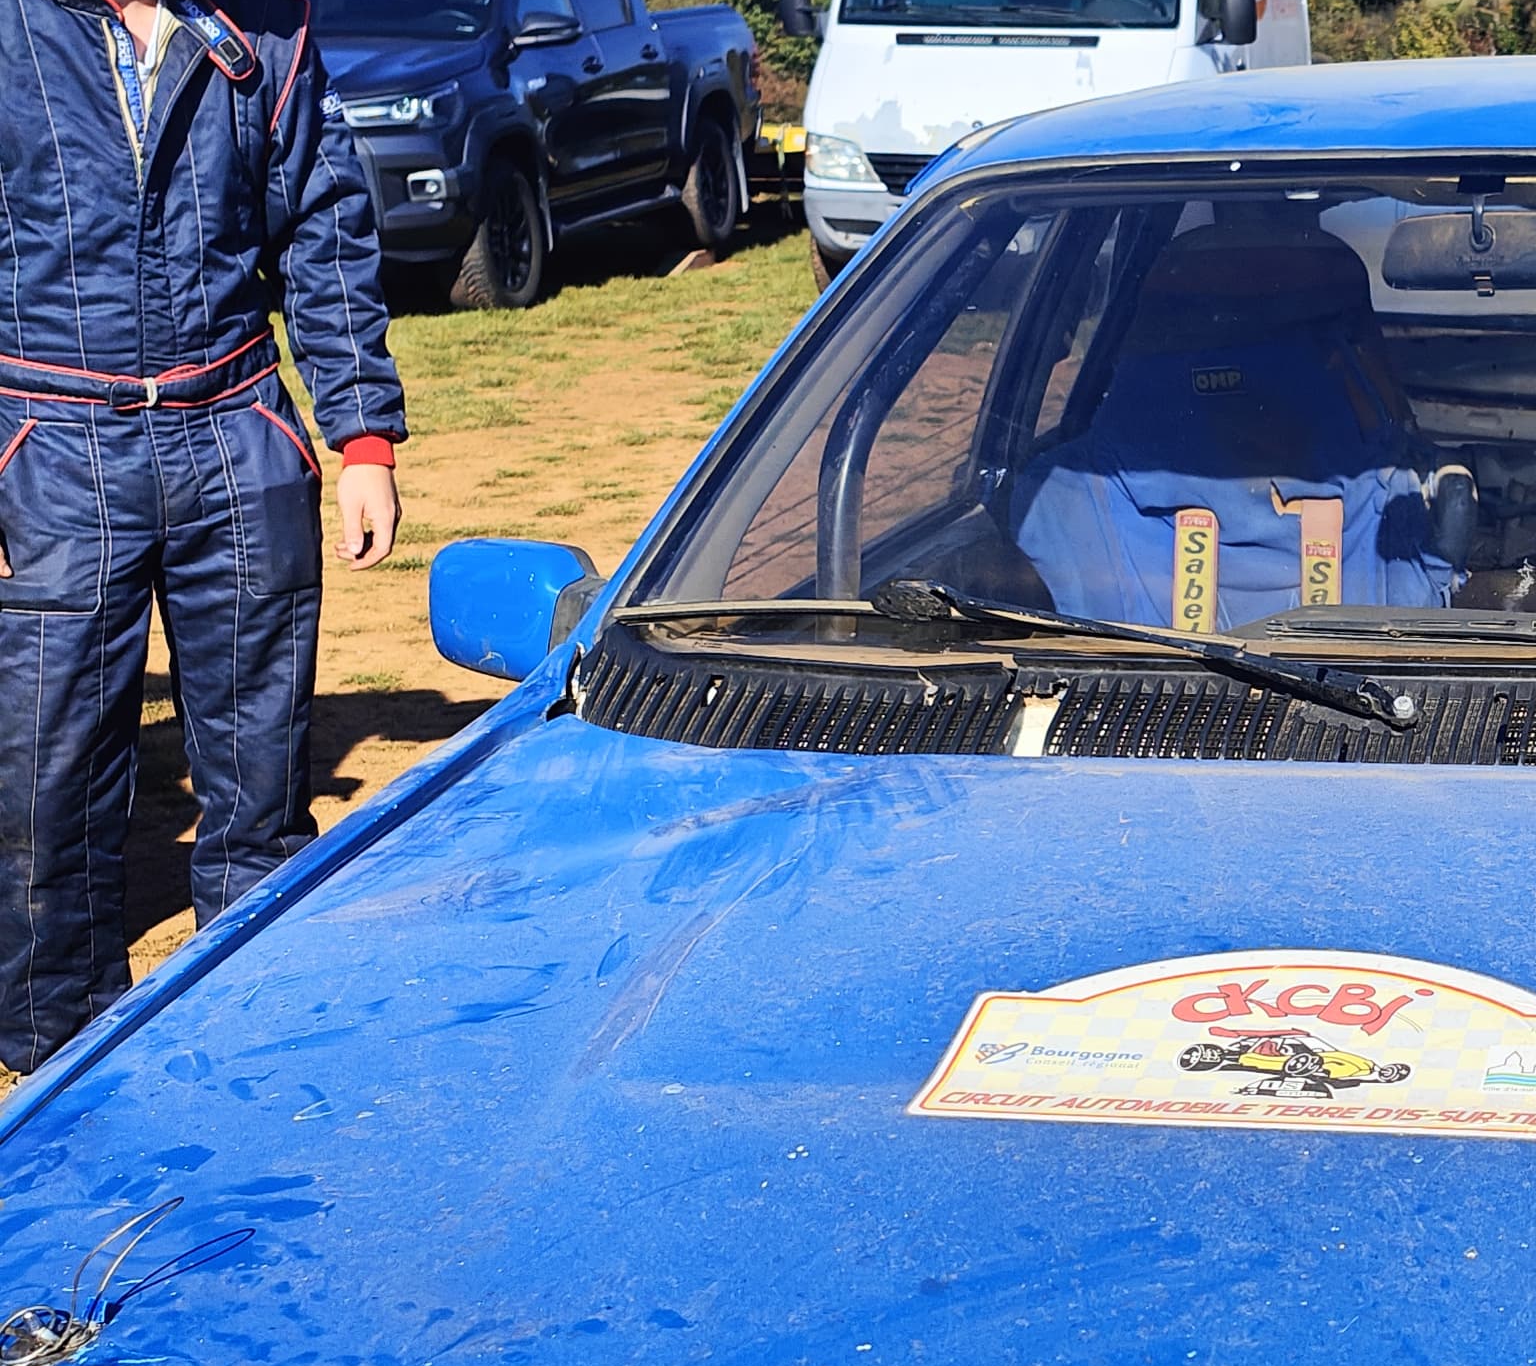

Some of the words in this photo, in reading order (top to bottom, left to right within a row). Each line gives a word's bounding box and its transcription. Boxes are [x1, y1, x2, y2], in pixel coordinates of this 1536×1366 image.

[1030, 1046, 1143, 1061] Bourgogne
[938, 1091, 1056, 1107] CIRCUIT
[1052, 1096, 1254, 1116] AUTOMOBILE
[1265, 1104, 1361, 1119] TERRE
